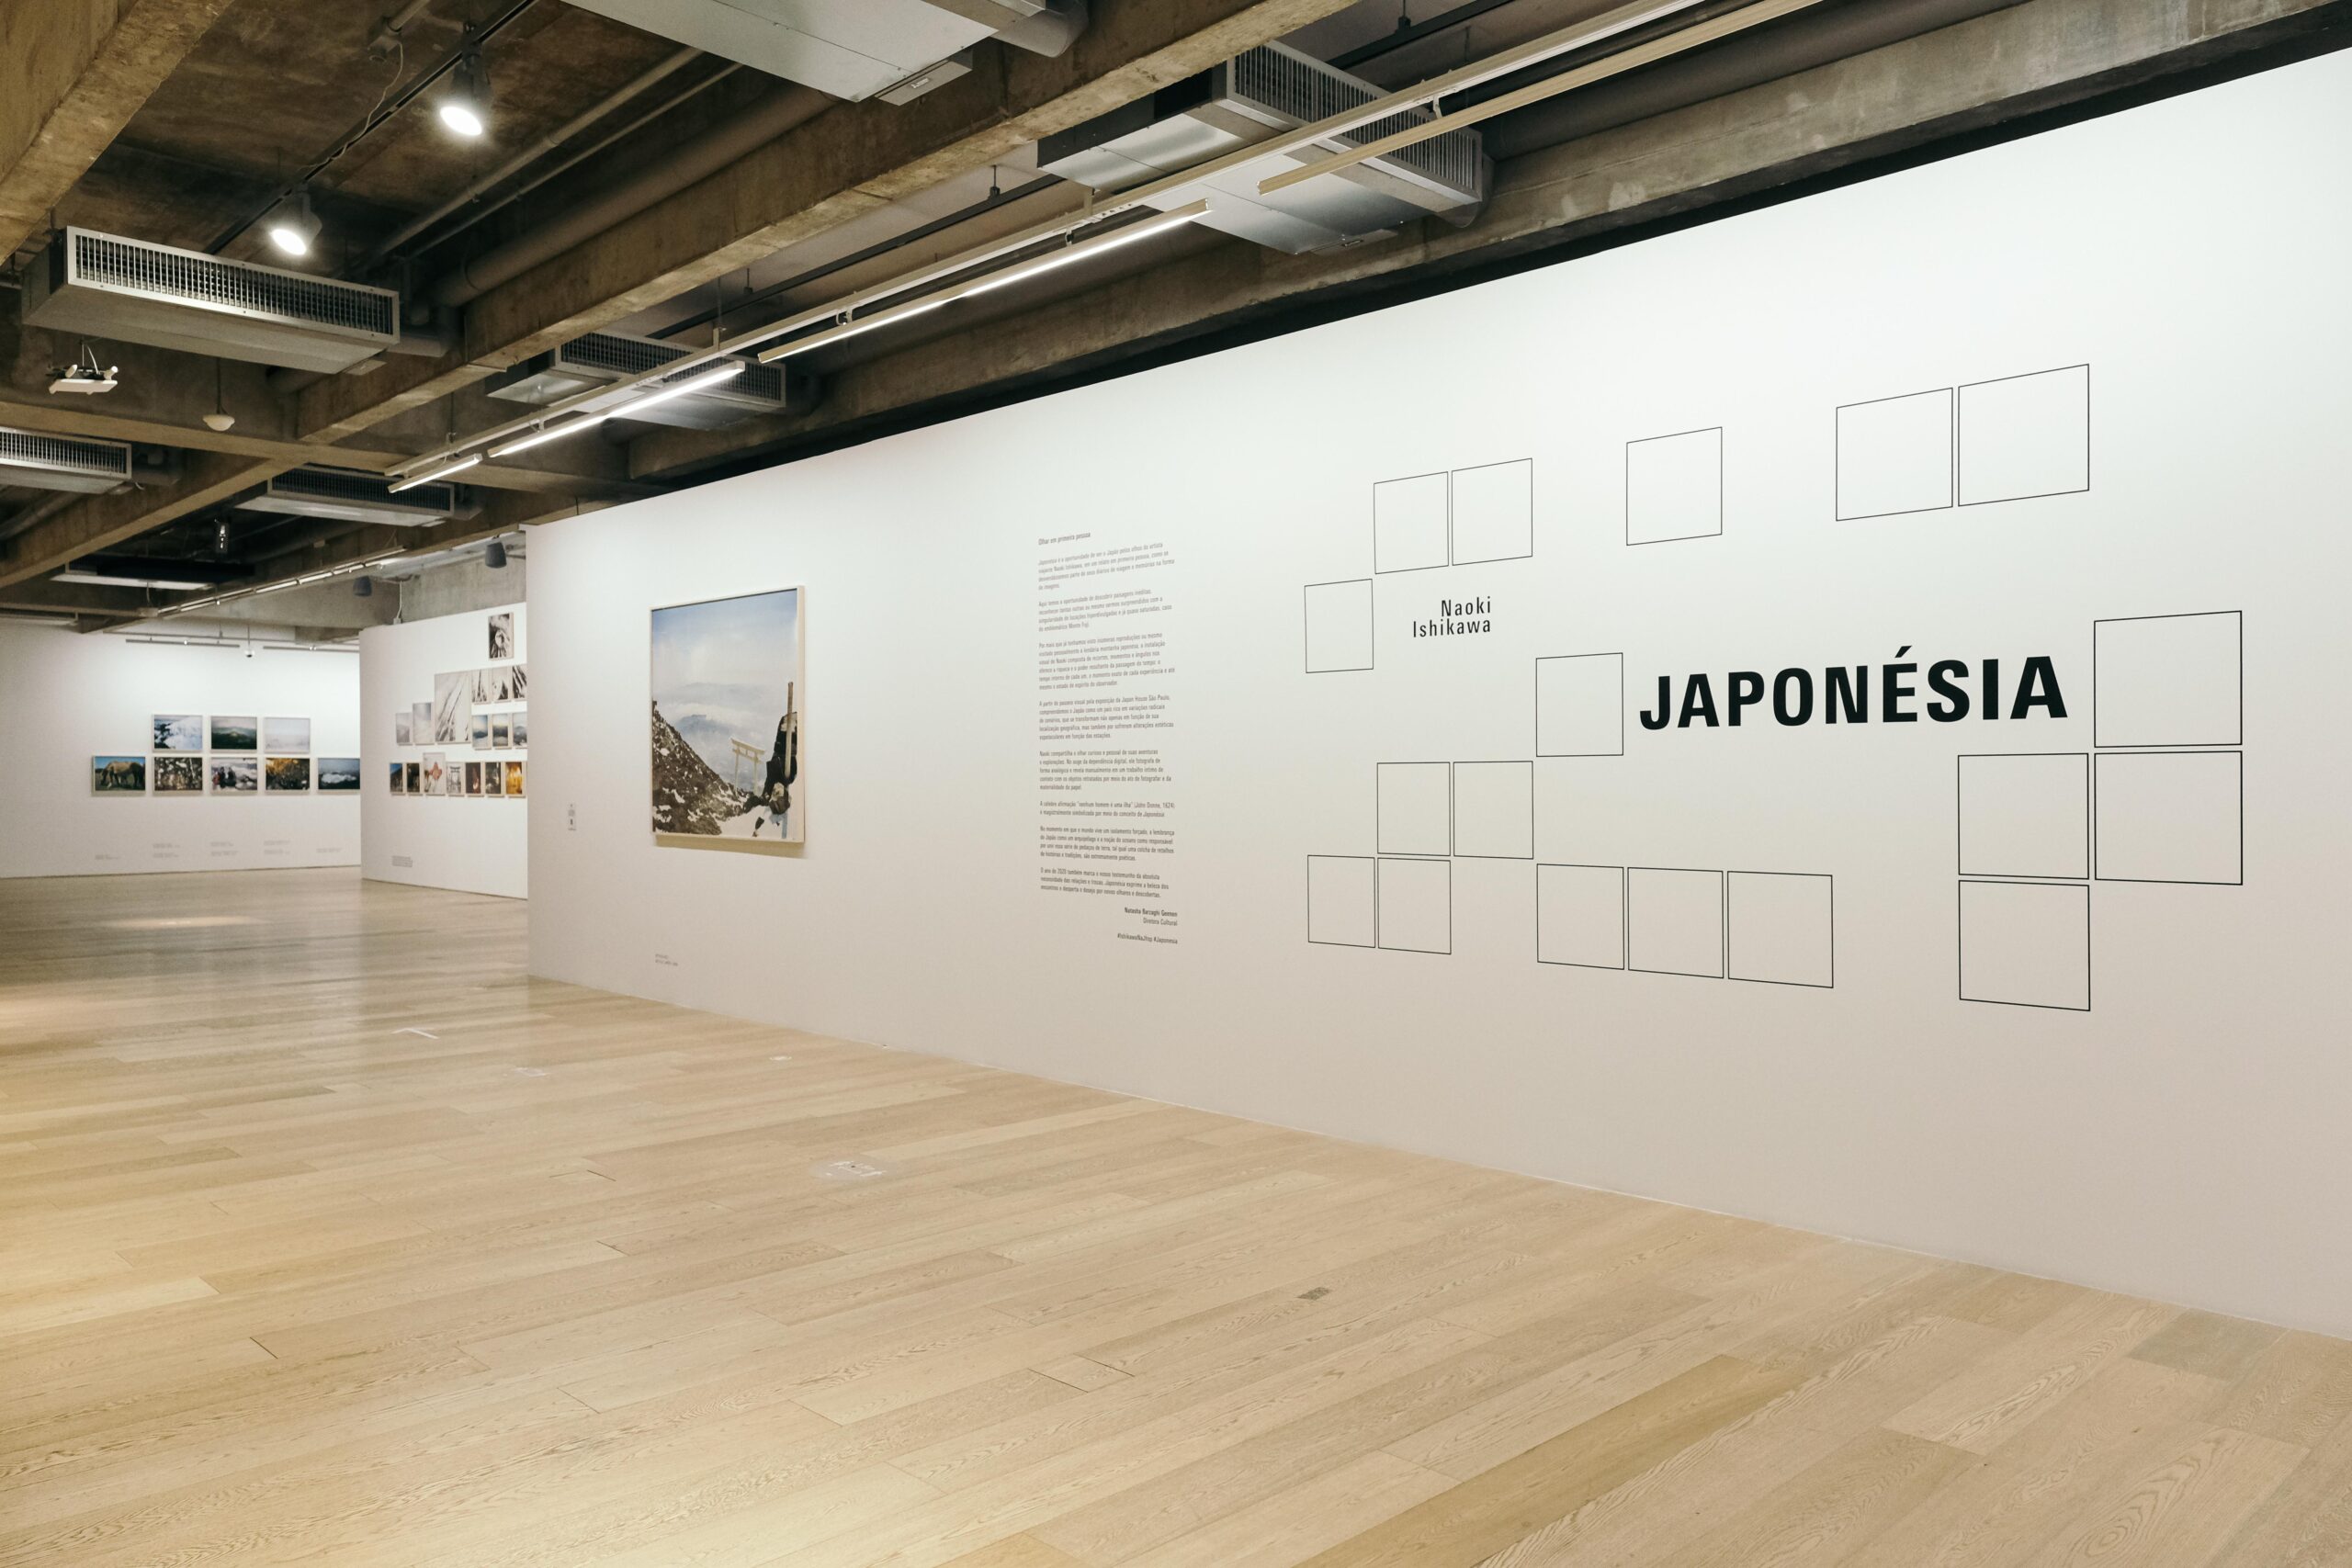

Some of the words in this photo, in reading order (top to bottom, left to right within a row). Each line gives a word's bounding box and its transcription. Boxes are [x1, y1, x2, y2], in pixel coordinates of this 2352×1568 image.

[1441, 595, 1490, 617] Naoki
[1413, 617, 1491, 638] Ishikawa
[1639, 645, 2068, 731] JAPONÉSIA
